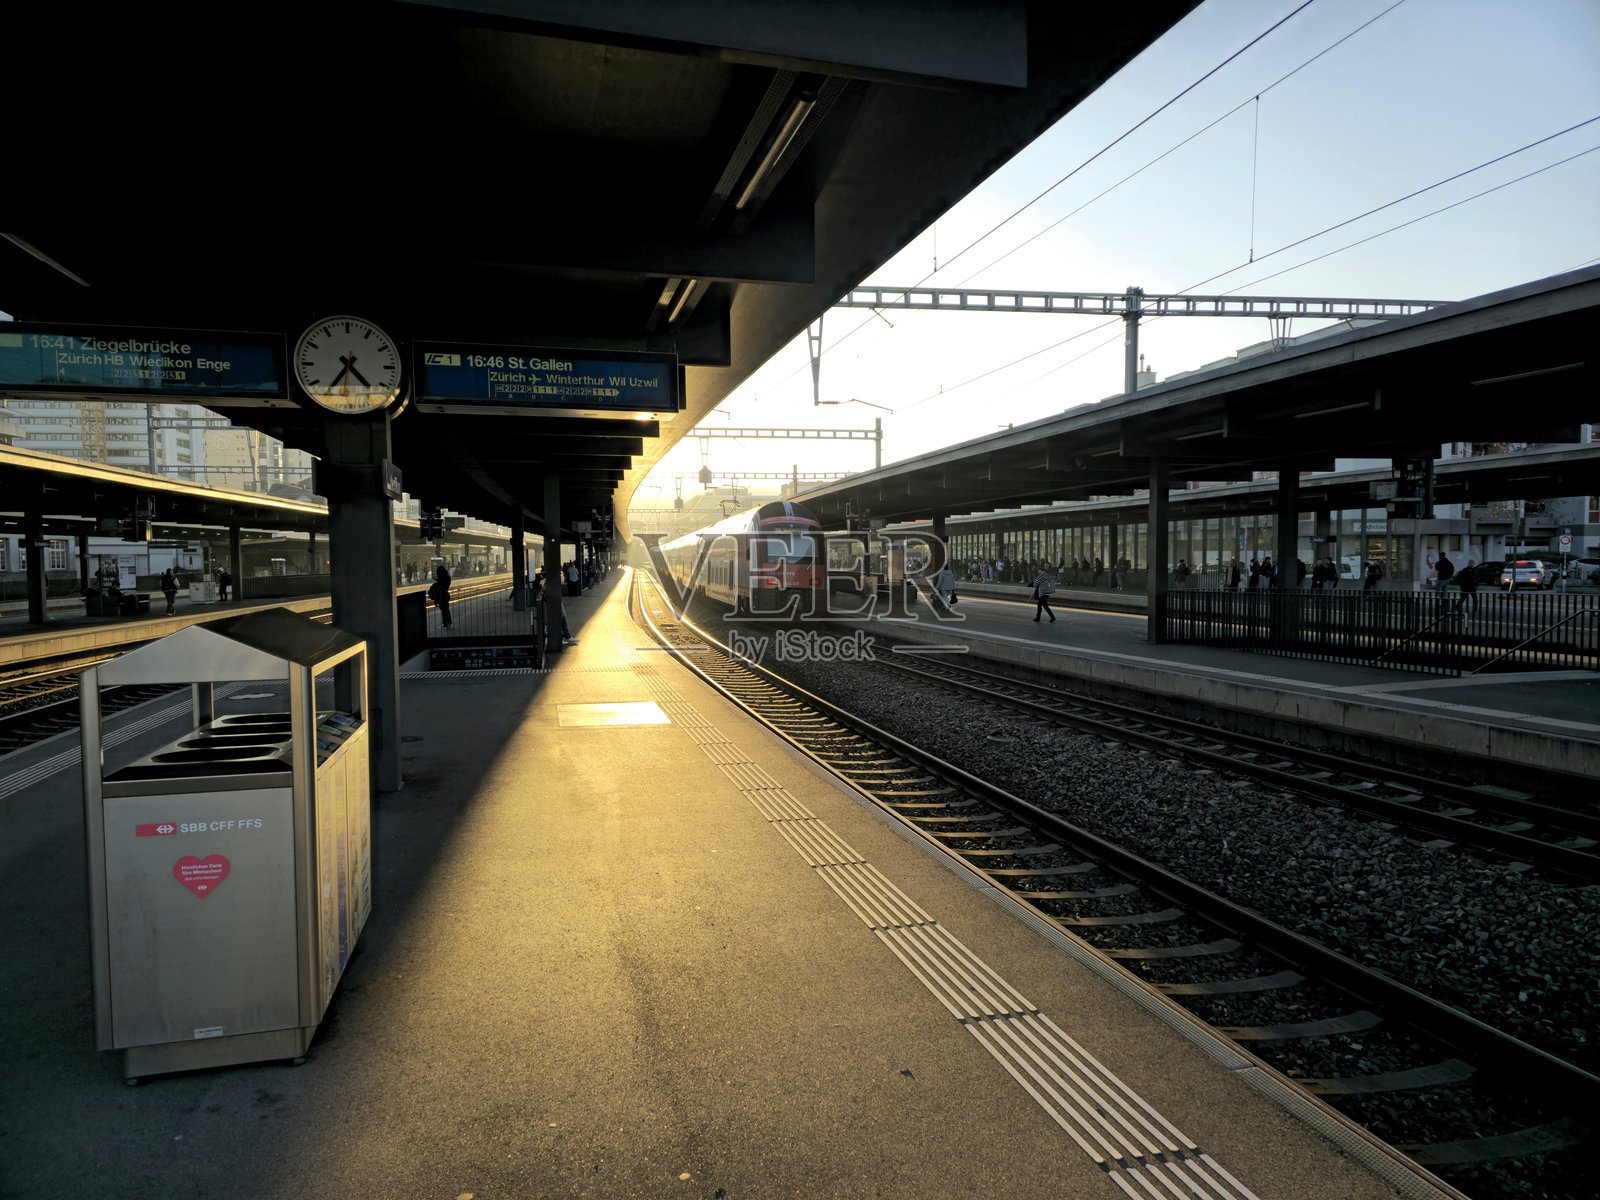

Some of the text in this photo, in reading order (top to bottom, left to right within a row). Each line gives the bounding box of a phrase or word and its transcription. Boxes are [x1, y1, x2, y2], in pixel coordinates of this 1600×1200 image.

[30, 336, 192, 355] 16:41 Ziegelbrücke
[58, 352, 232, 372] Zürich HB Wiedikon Enge
[426, 355, 572, 371] IC 1 16:46 St. Gallen
[490, 371, 658, 388] Zürich Winterthur Wil Uzwil
[180, 818, 262, 833] SBB CFF FFS
